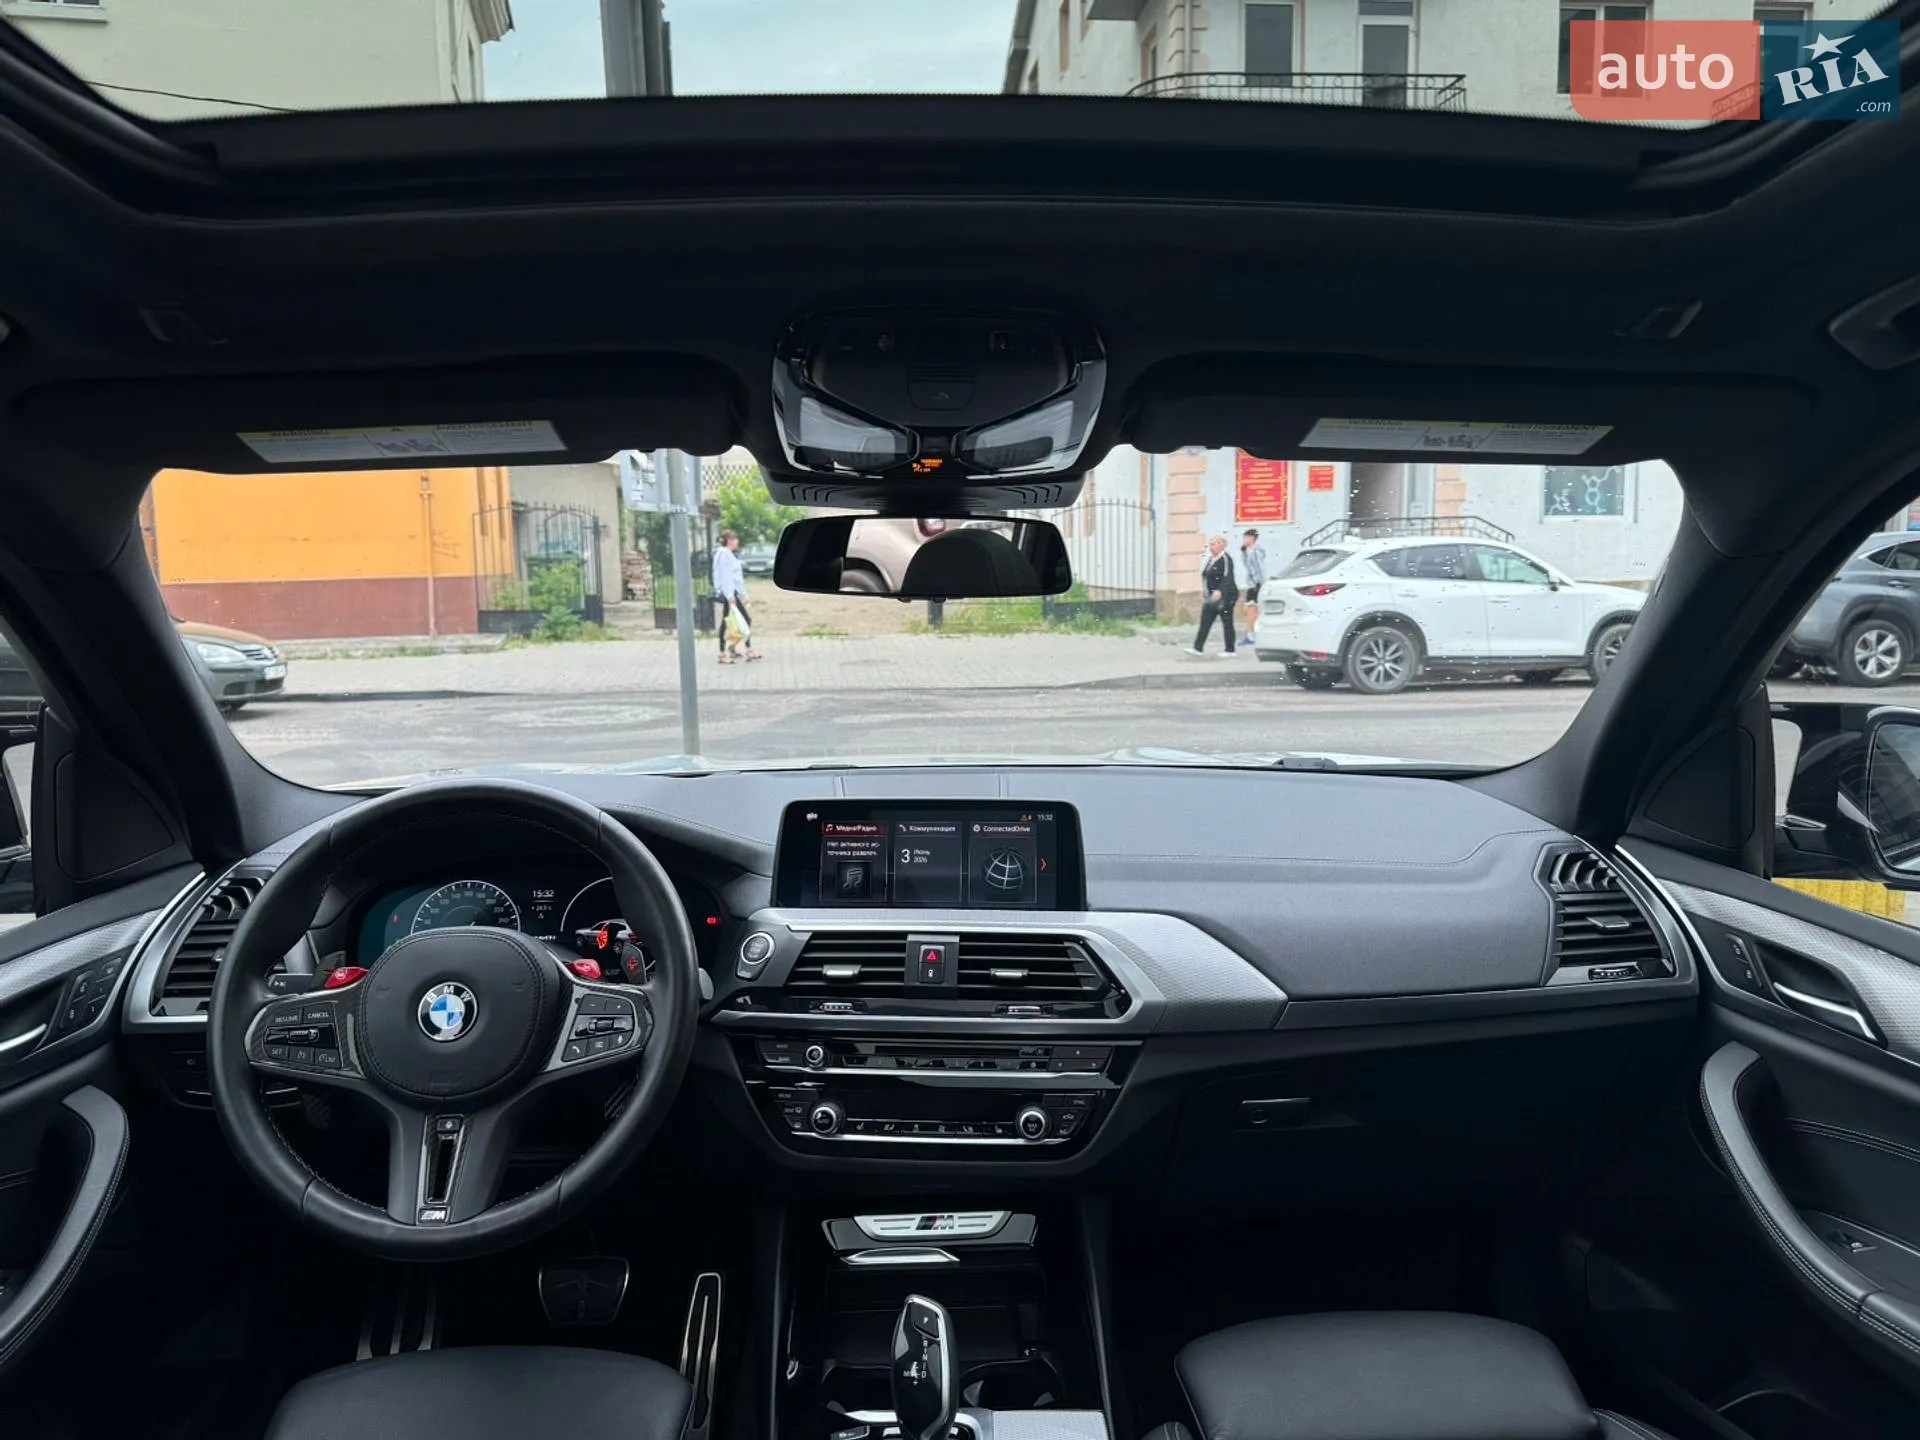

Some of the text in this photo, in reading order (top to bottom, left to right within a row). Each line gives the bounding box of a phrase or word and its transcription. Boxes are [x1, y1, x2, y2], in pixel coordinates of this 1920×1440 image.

[983, 824, 1031, 833] ConnectedDrive
[900, 848, 911, 864] 3
[532, 889, 555, 898] 15:32
[426, 985, 473, 1004] BMW
[275, 1014, 299, 1023] RESUME
[307, 1011, 330, 1020] CANCEL
[271, 1048, 282, 1056] SET
